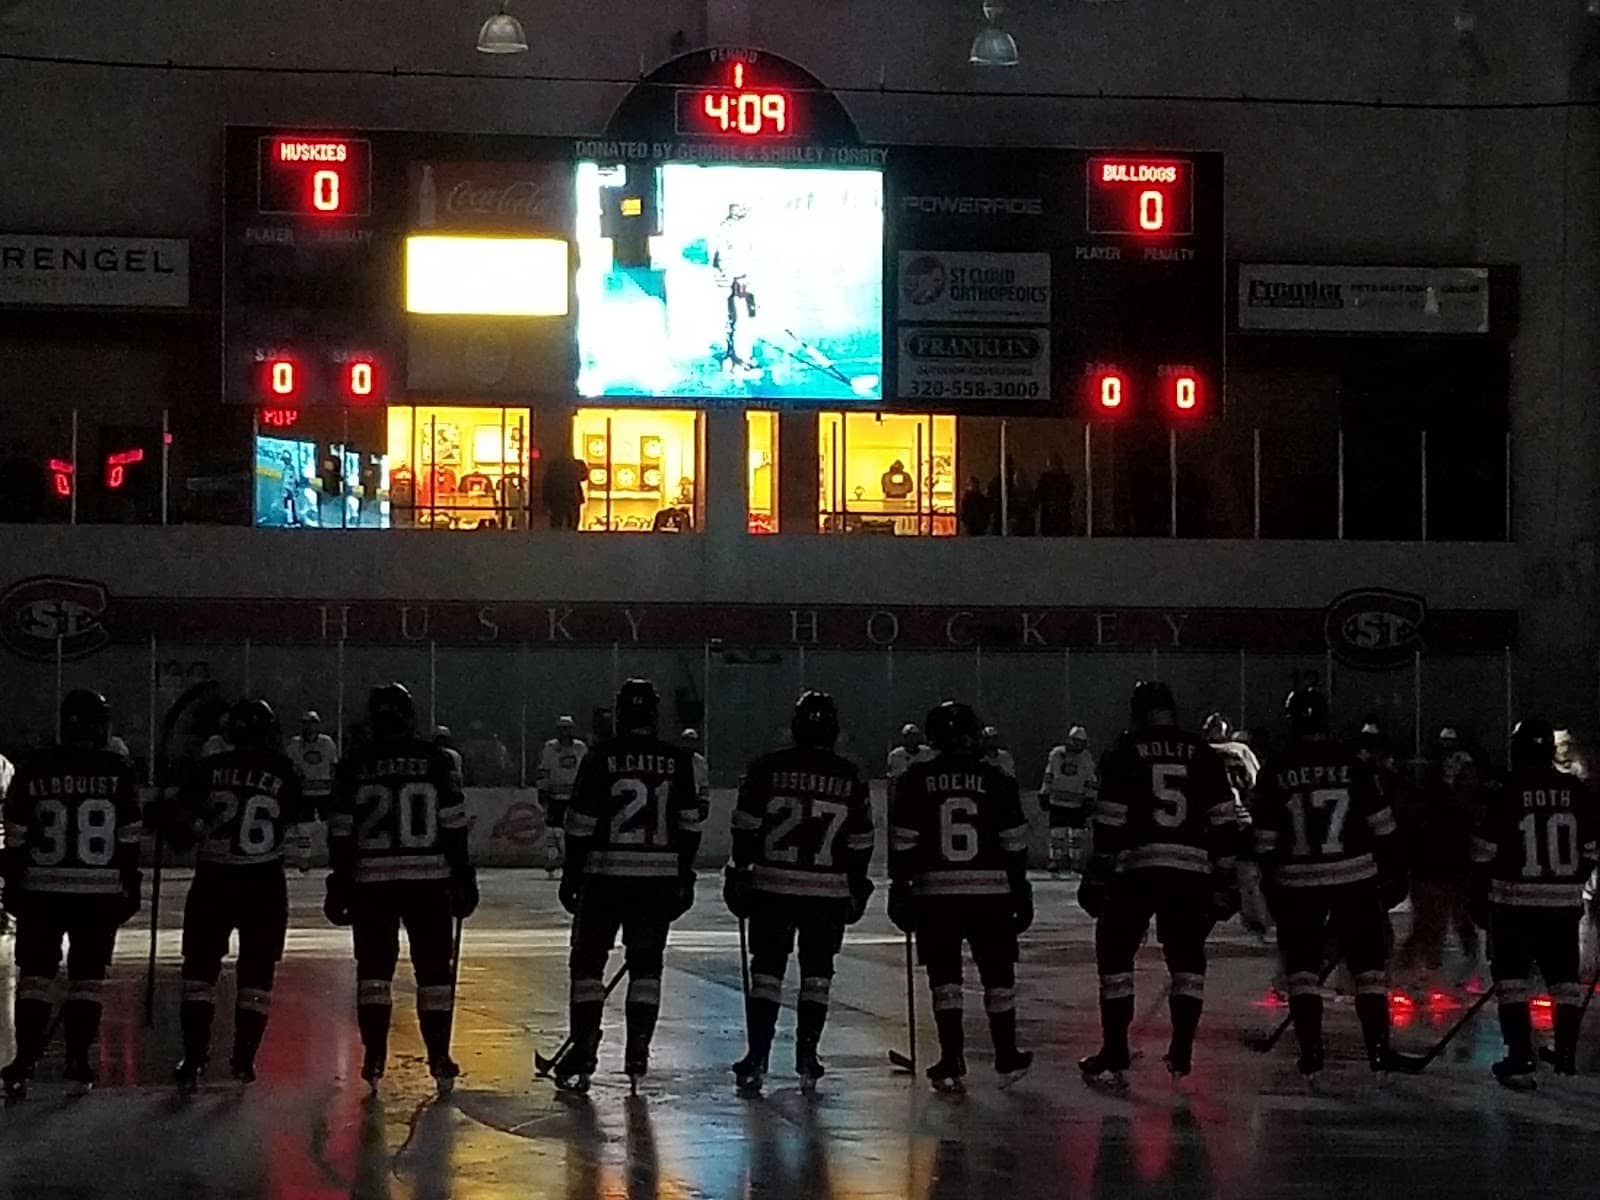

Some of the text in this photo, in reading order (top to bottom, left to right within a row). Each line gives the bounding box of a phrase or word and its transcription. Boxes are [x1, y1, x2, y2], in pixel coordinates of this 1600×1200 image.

[733, 62, 744, 89] 1
[704, 93, 786, 134] 4:09
[280, 142, 347, 162] HUSKIES
[575, 141, 647, 159] DONATED
[651, 143, 674, 159] BY
[1102, 164, 1177, 183] BULLDOGS
[312, 169, 340, 212] 0
[1138, 190, 1164, 231] 0
[245, 227, 294, 244] PLAYER
[3, 246, 174, 273] RENGEL
[1074, 246, 1196, 262] PLAYER PENALTY
[950, 286, 1047, 302] ORTHOPEDICS
[916, 336, 1032, 356] FRANKLIN
[273, 362, 293, 394] 0
[352, 363, 371, 395] 0
[1101, 376, 1121, 408] 0
[1176, 377, 1196, 409] 0
[319, 605, 1189, 649] HUSKY HOCKEY
[925, 773, 988, 794] ROEHL
[1151, 763, 1189, 828] 5
[1522, 788, 1572, 808] ROTH
[203, 790, 281, 856] 26
[354, 781, 438, 849] 20
[610, 778, 670, 847] 21
[1285, 788, 1350, 855] 17
[31, 798, 116, 867] 38
[763, 795, 848, 867] 27
[939, 796, 979, 862] 6
[1518, 811, 1580, 878] 10
